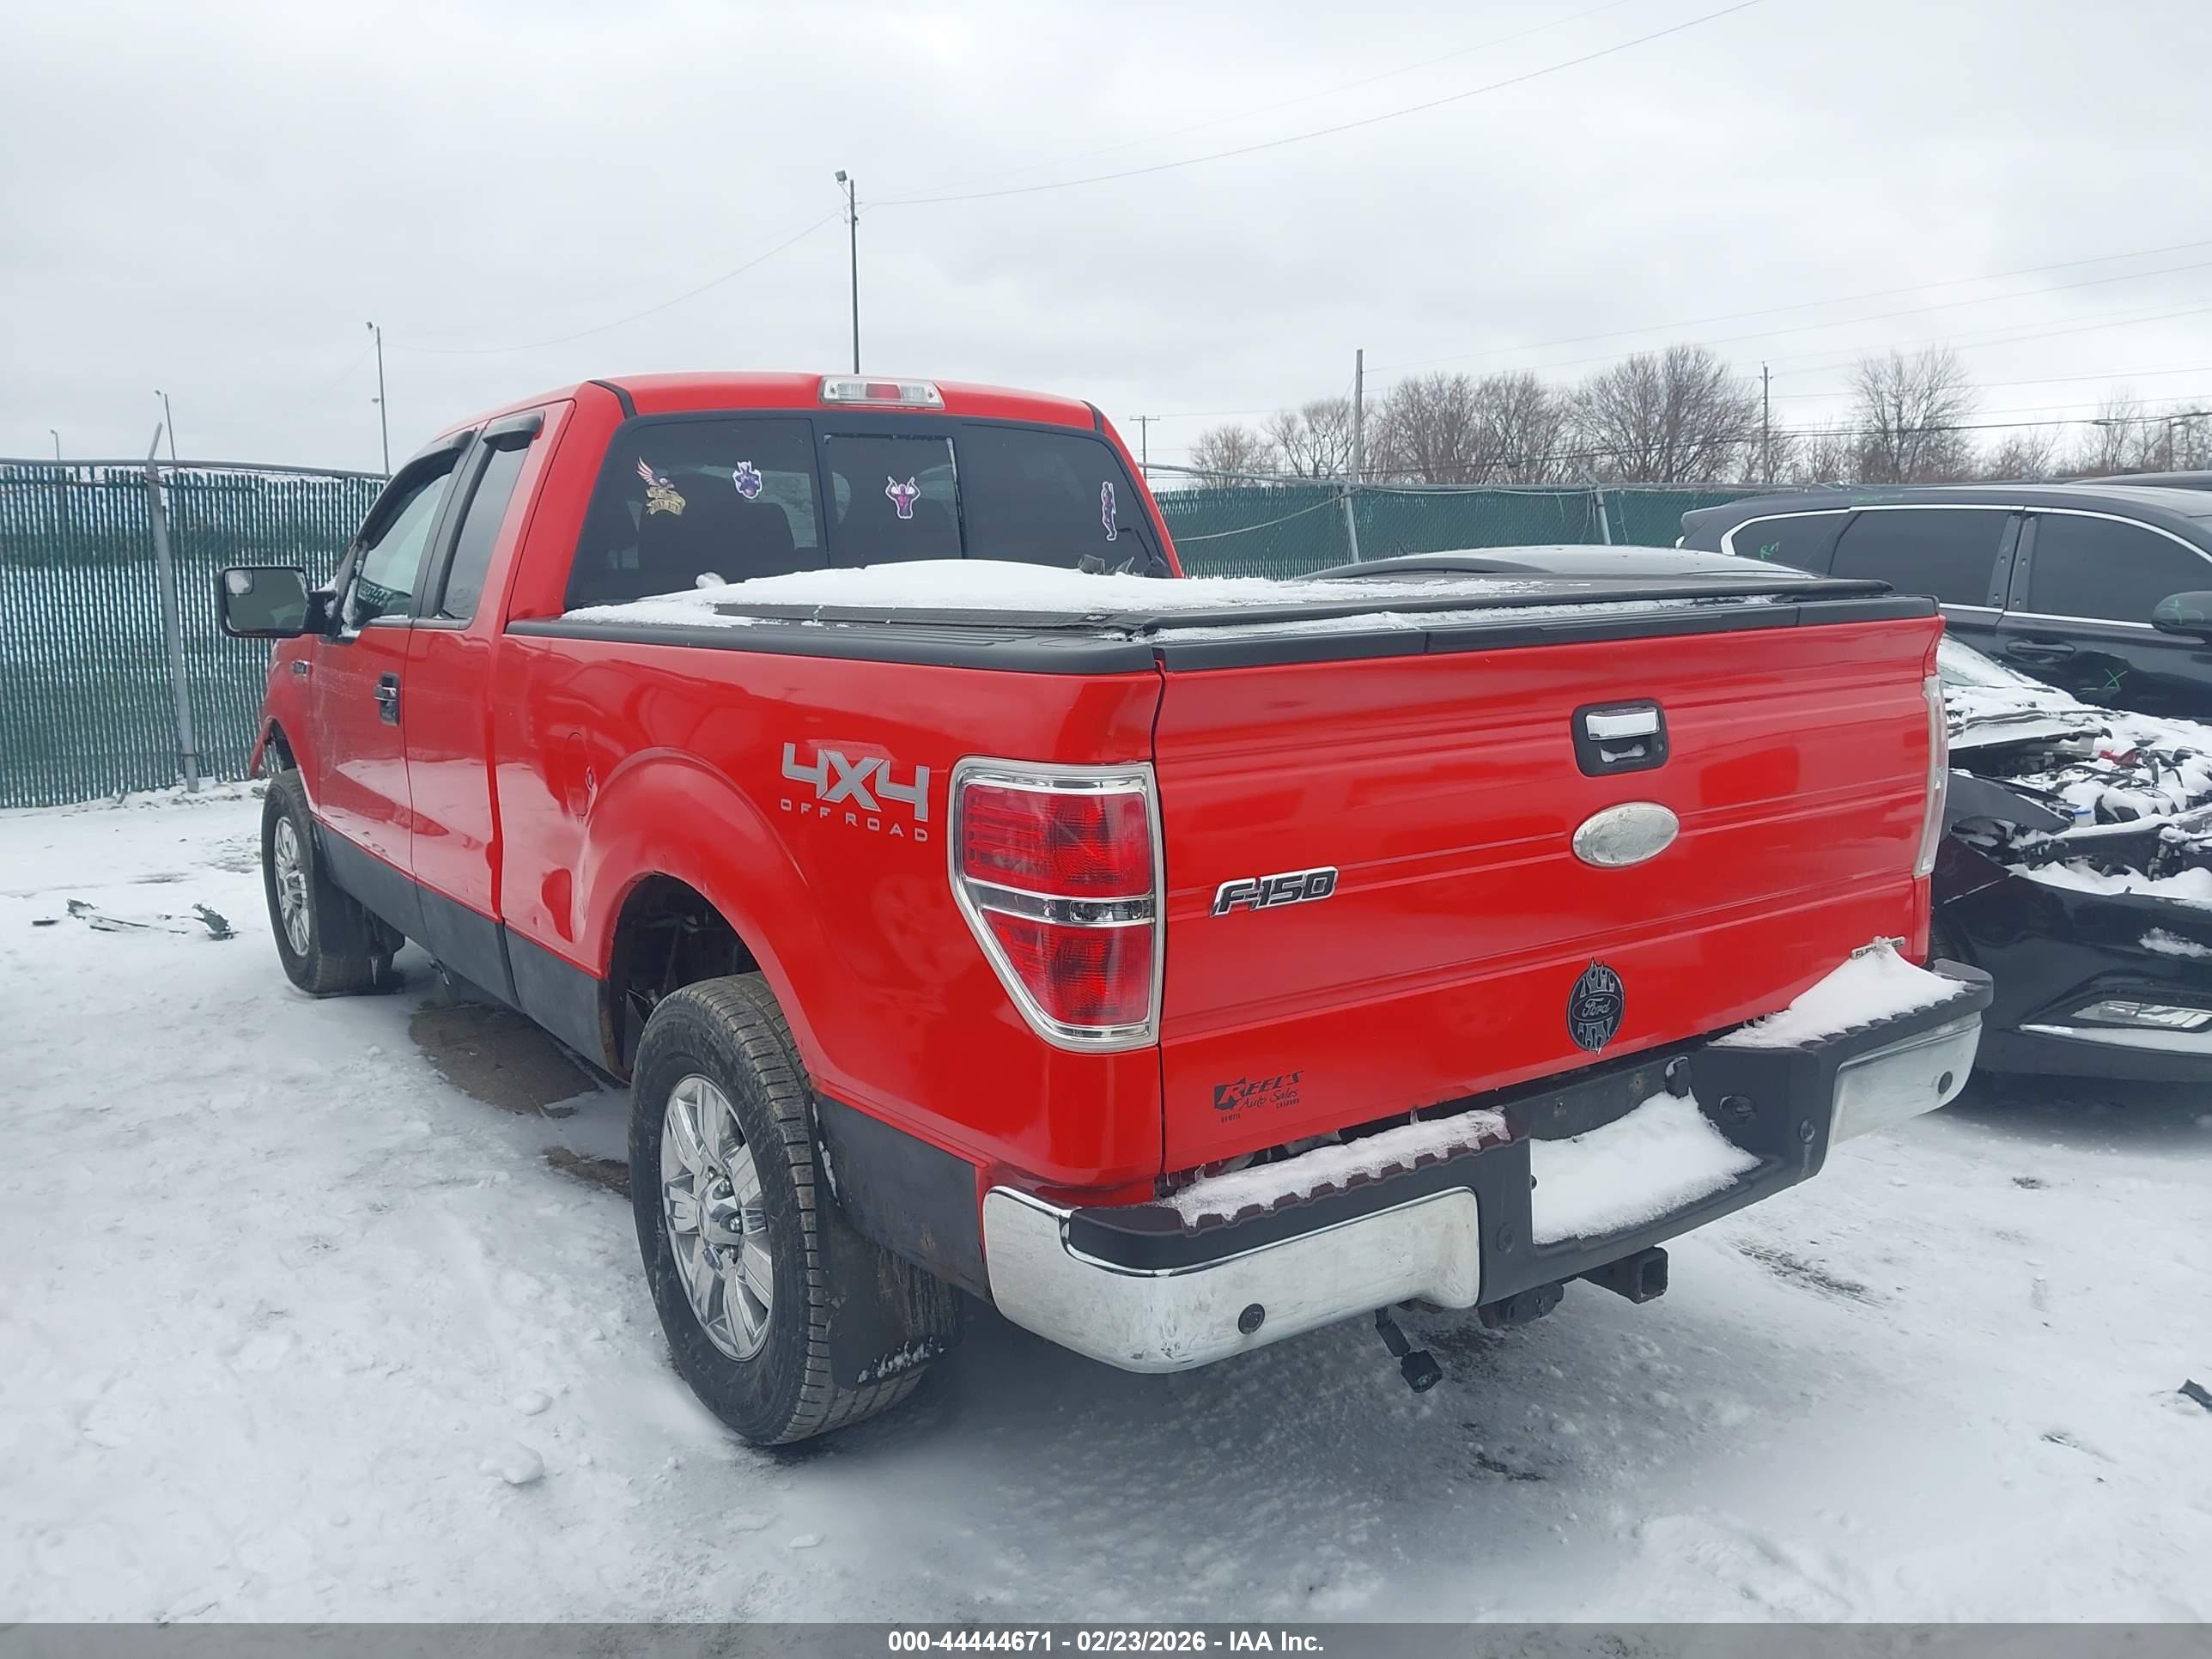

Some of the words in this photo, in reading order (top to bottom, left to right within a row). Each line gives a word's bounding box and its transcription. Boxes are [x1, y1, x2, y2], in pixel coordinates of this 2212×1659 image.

[781, 742, 930, 822] 4X4
[780, 798, 831, 819] OFF
[845, 811, 928, 842] ROAD
[1210, 866, 1339, 918] F-150
[1581, 997, 1611, 1018] Ford
[1239, 1097, 1267, 1111] Auto
[1270, 1088, 1298, 1103] Sales
